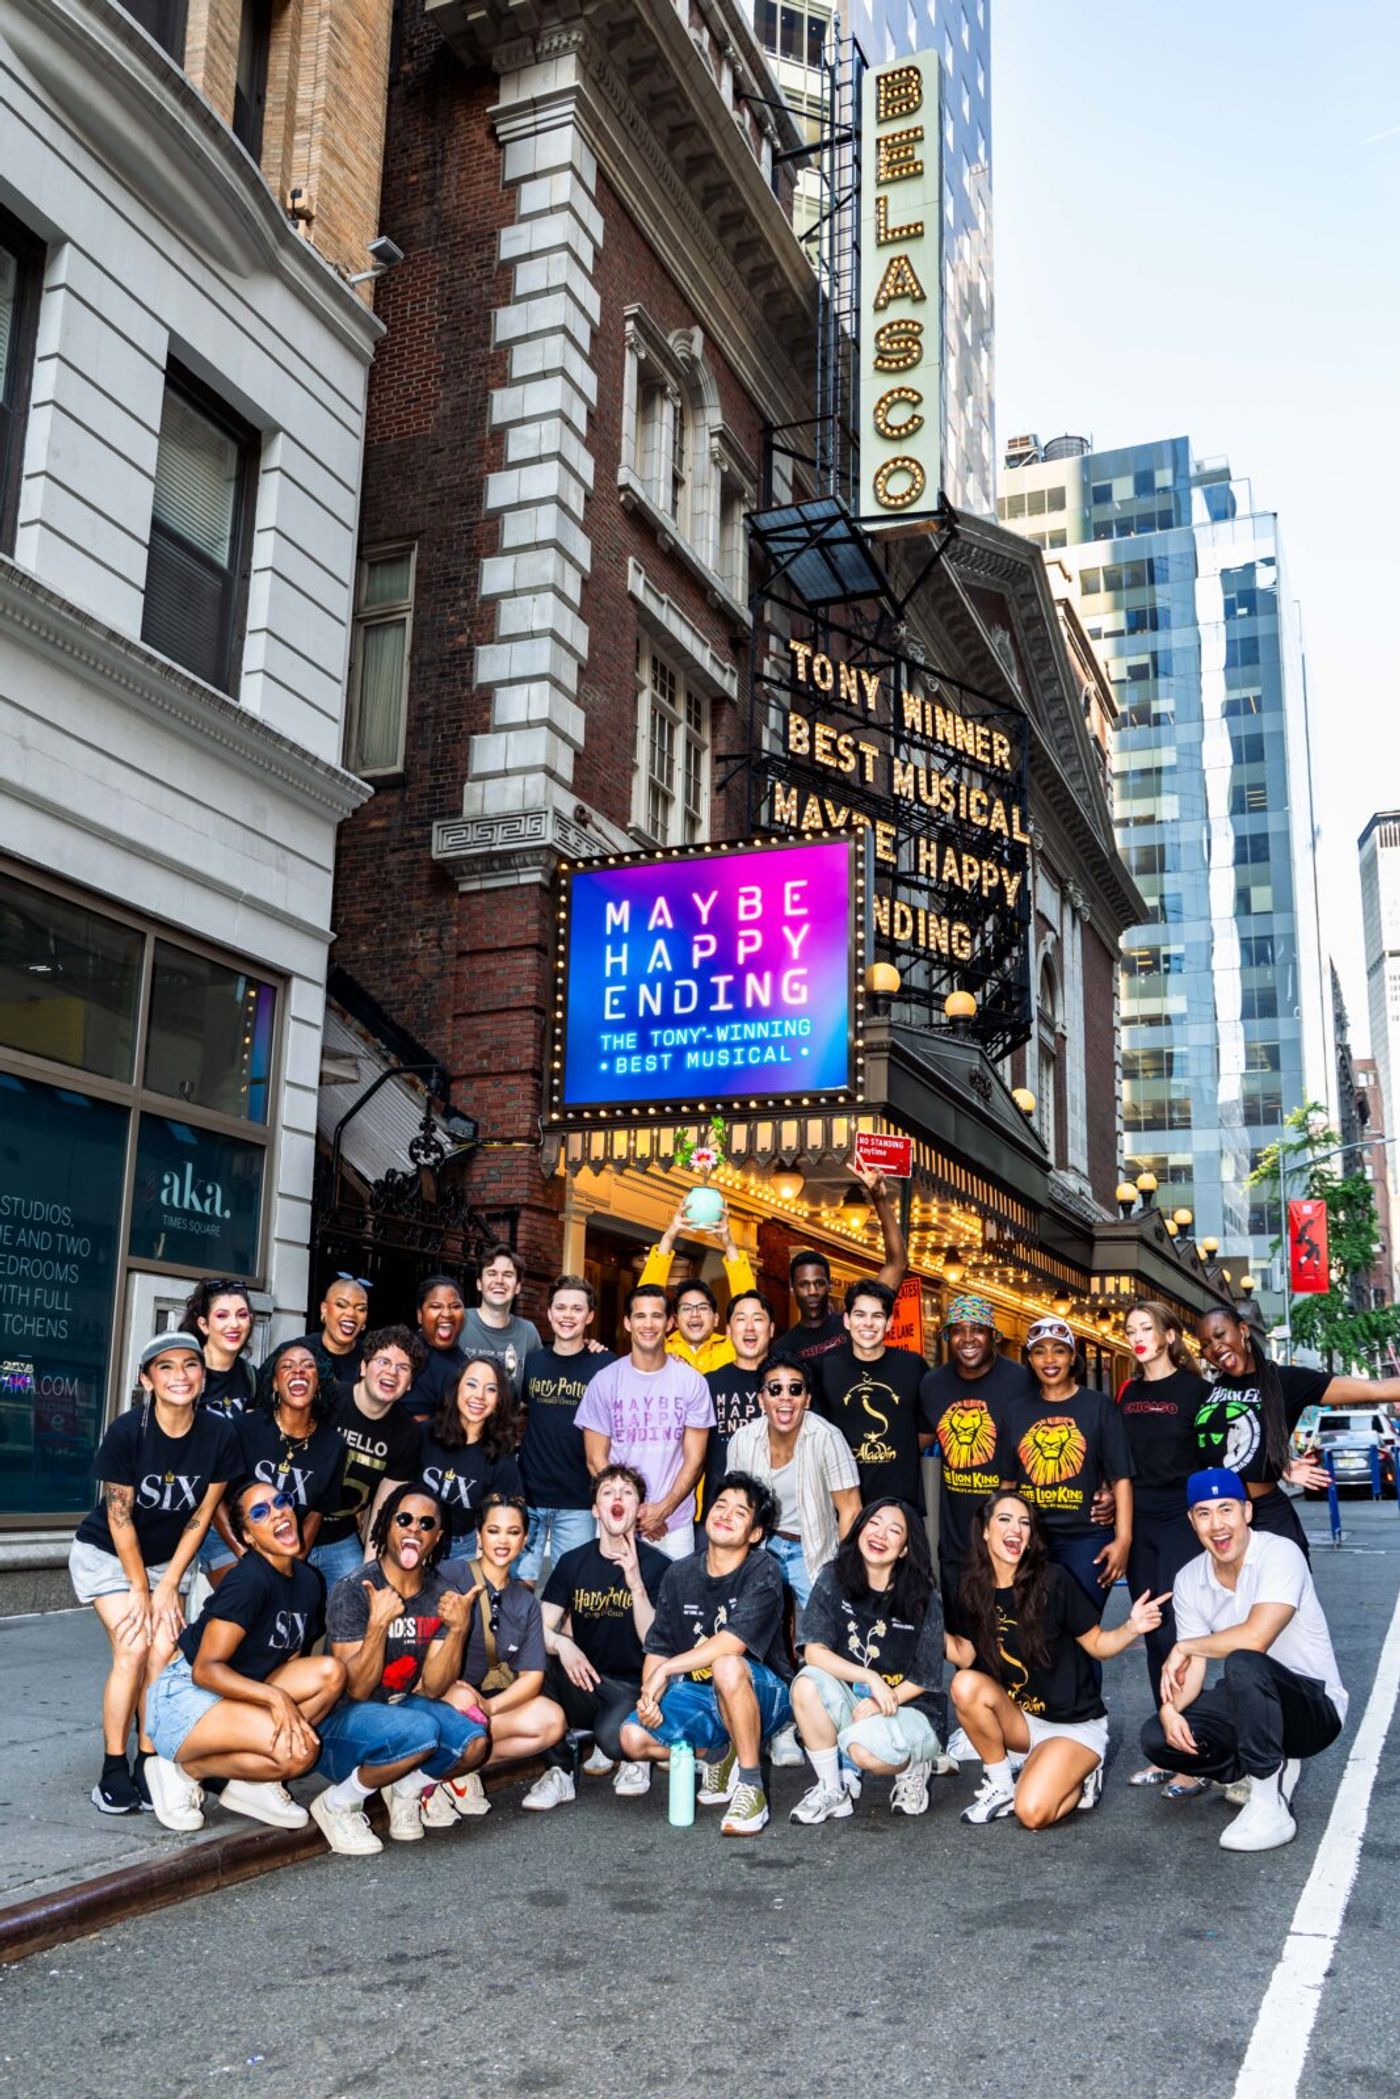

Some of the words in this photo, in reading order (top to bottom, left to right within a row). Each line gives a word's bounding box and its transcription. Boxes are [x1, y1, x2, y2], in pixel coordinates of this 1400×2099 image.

[873, 65, 927, 509] BELASCO
[789, 639, 880, 713] TONY
[902, 690, 1012, 771] WINNER
[788, 711, 879, 784] BEST
[892, 757, 1031, 845] MUSICAL
[773, 781, 898, 865] MAYE
[918, 837, 1023, 908] HAPPY
[605, 880, 809, 935] MAYBE
[872, 894, 972, 961] NDING
[605, 924, 810, 978] HAPPY
[603, 968, 809, 1021] ENDING
[600, 1032, 638, 1051] THE
[615, 1053, 672, 1075] BEST
[687, 1045, 792, 1069] MUSICAL
[859, 1136, 869, 1146] NO
[871, 1138, 905, 1150] STANDING
[859, 1145, 887, 1157] Anytime
[161, 1161, 231, 1219] aka.
[163, 1214, 188, 1231] TIMES
[189, 1219, 223, 1238] SQUARE
[16, 1227, 53, 1251] AND
[56, 1233, 91, 1257] TWO
[0, 1283, 31, 1307] ITH
[34, 1287, 73, 1311] FULL
[2, 1313, 69, 1339] TCHENS
[897, 1323, 914, 1339] LANE
[529, 1376, 557, 1398] Harry
[558, 1376, 588, 1398] Potte
[716, 1392, 757, 1407] MAY
[614, 1396, 684, 1413] MAYBE
[717, 1405, 756, 1420] HAP
[614, 1411, 684, 1428] HAPPY
[615, 1427, 684, 1443] ENDING
[853, 1441, 897, 1461] Aladdin
[136, 1472, 201, 1511] SIX
[422, 1466, 477, 1509] SIX
[951, 1470, 972, 1486] LION
[972, 1471, 1000, 1488] KING
[1036, 1487, 1058, 1504] LION
[1058, 1486, 1084, 1504] KING
[574, 1588, 606, 1613] Harry
[606, 1586, 633, 1611] Potte
[268, 1610, 308, 1649] SX
